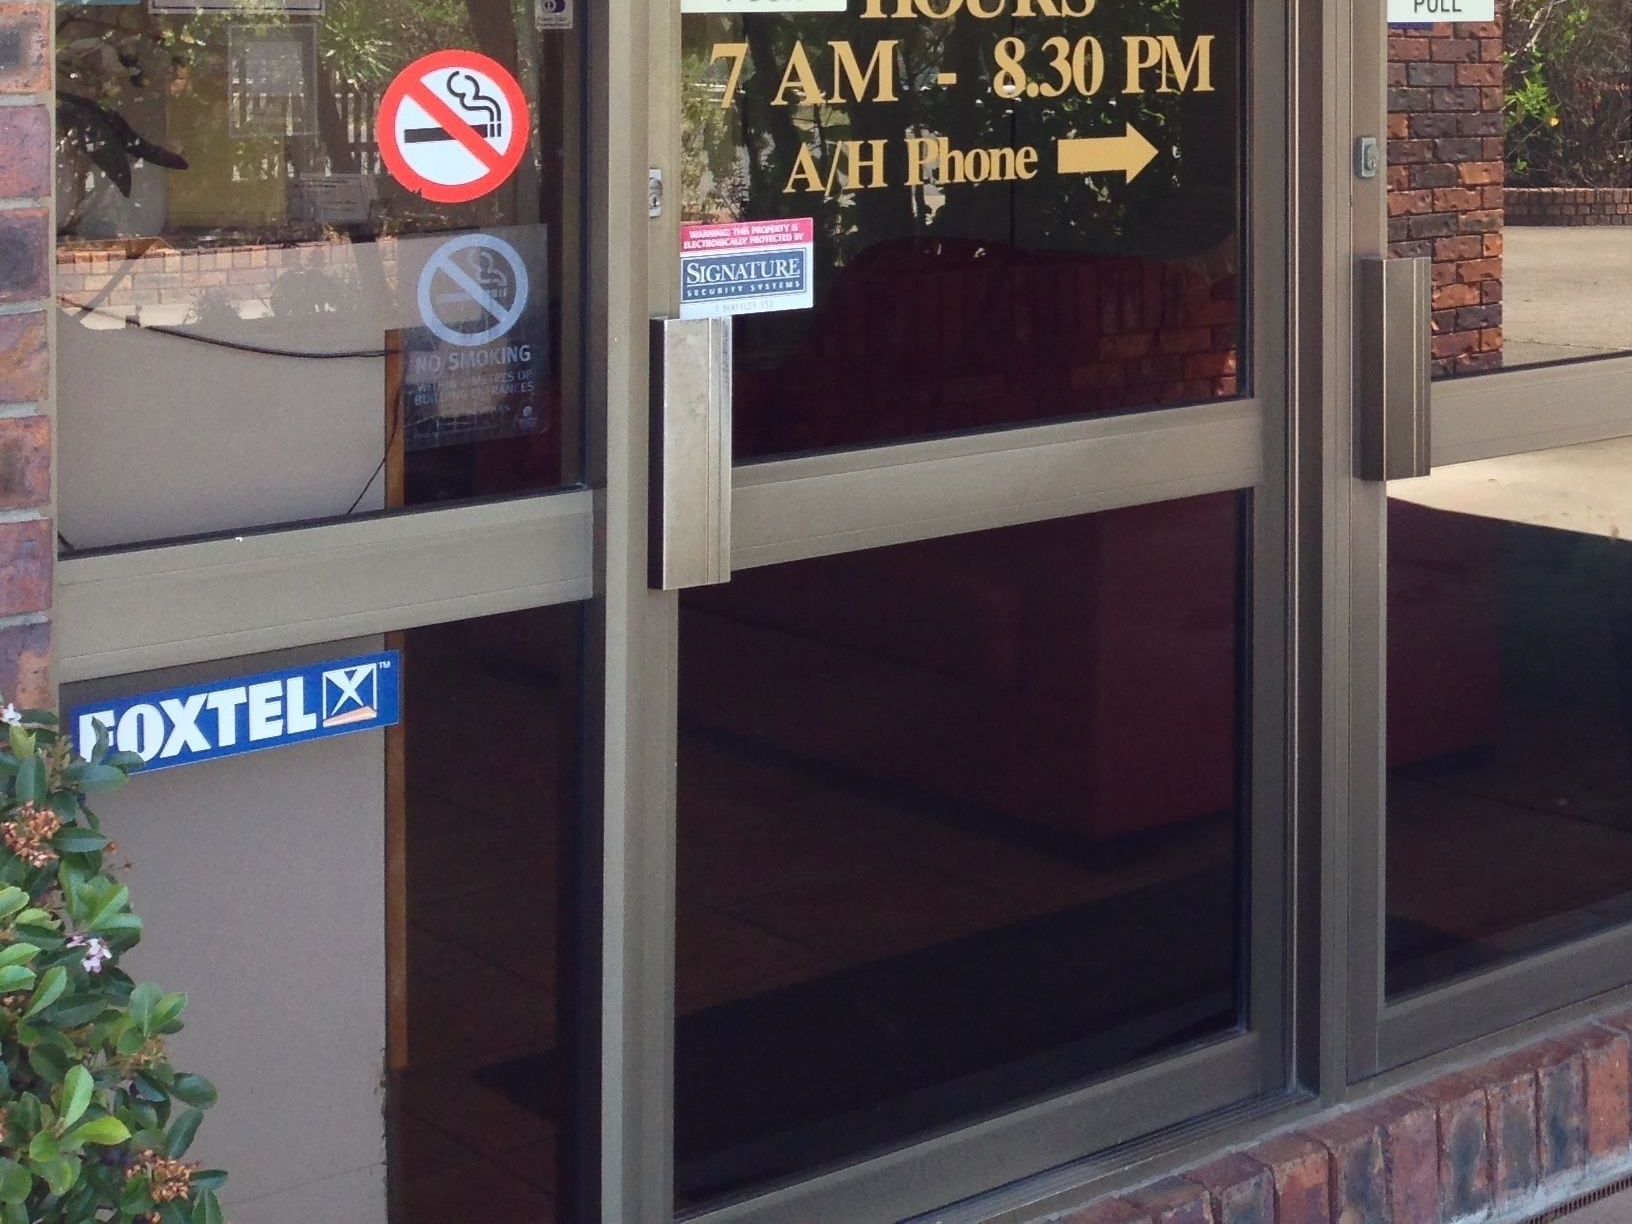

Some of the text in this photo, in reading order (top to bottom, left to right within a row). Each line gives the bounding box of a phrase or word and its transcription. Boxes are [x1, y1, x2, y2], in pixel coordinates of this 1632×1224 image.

[709, 41, 749, 109] 7
[770, 38, 899, 107] AM
[993, 36, 1106, 99] 8.30
[1122, 34, 1216, 95] PM
[782, 135, 1038, 195] A/H Phone
[687, 258, 801, 285] SIGNATURE
[687, 280, 801, 298] SECURITY SYSTEMS
[416, 344, 531, 374] NO SMOKING
[79, 677, 317, 763] FOXTEL
